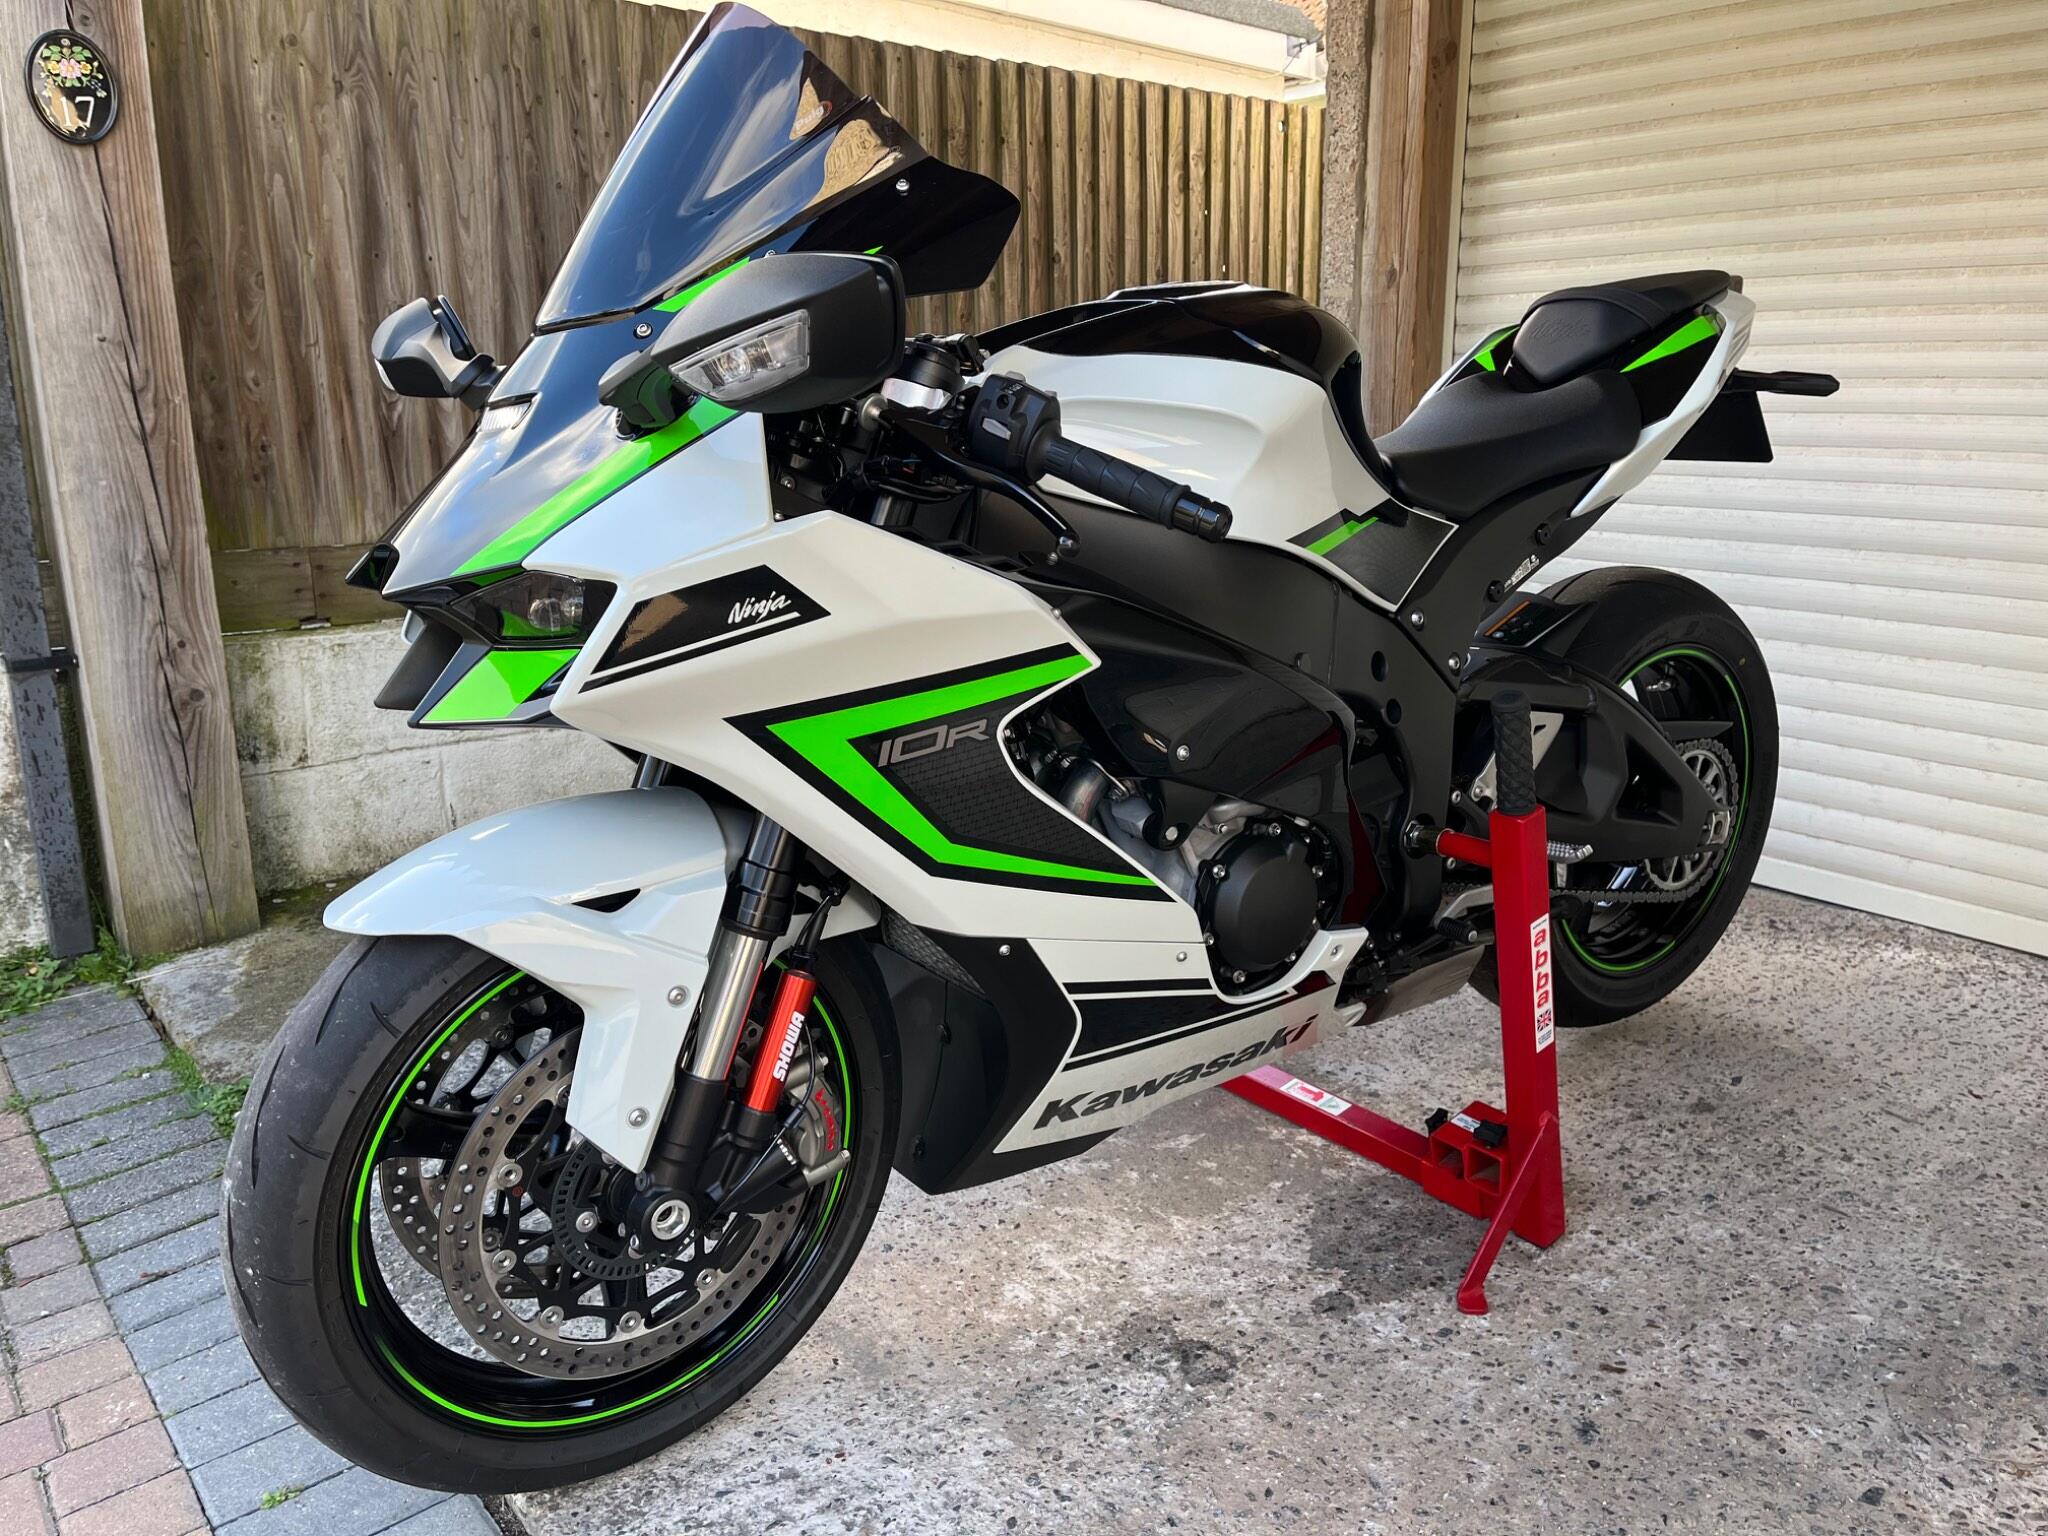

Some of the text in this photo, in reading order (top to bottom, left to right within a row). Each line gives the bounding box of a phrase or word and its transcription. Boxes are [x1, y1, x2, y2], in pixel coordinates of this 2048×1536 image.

[60, 96, 95, 128] 17
[727, 590, 792, 625] Ninja
[877, 718, 990, 768] 10R
[1533, 927, 1550, 1009] abba
[772, 1010, 806, 1082] SHOWA
[1032, 1013, 1320, 1131] Kawasaki
